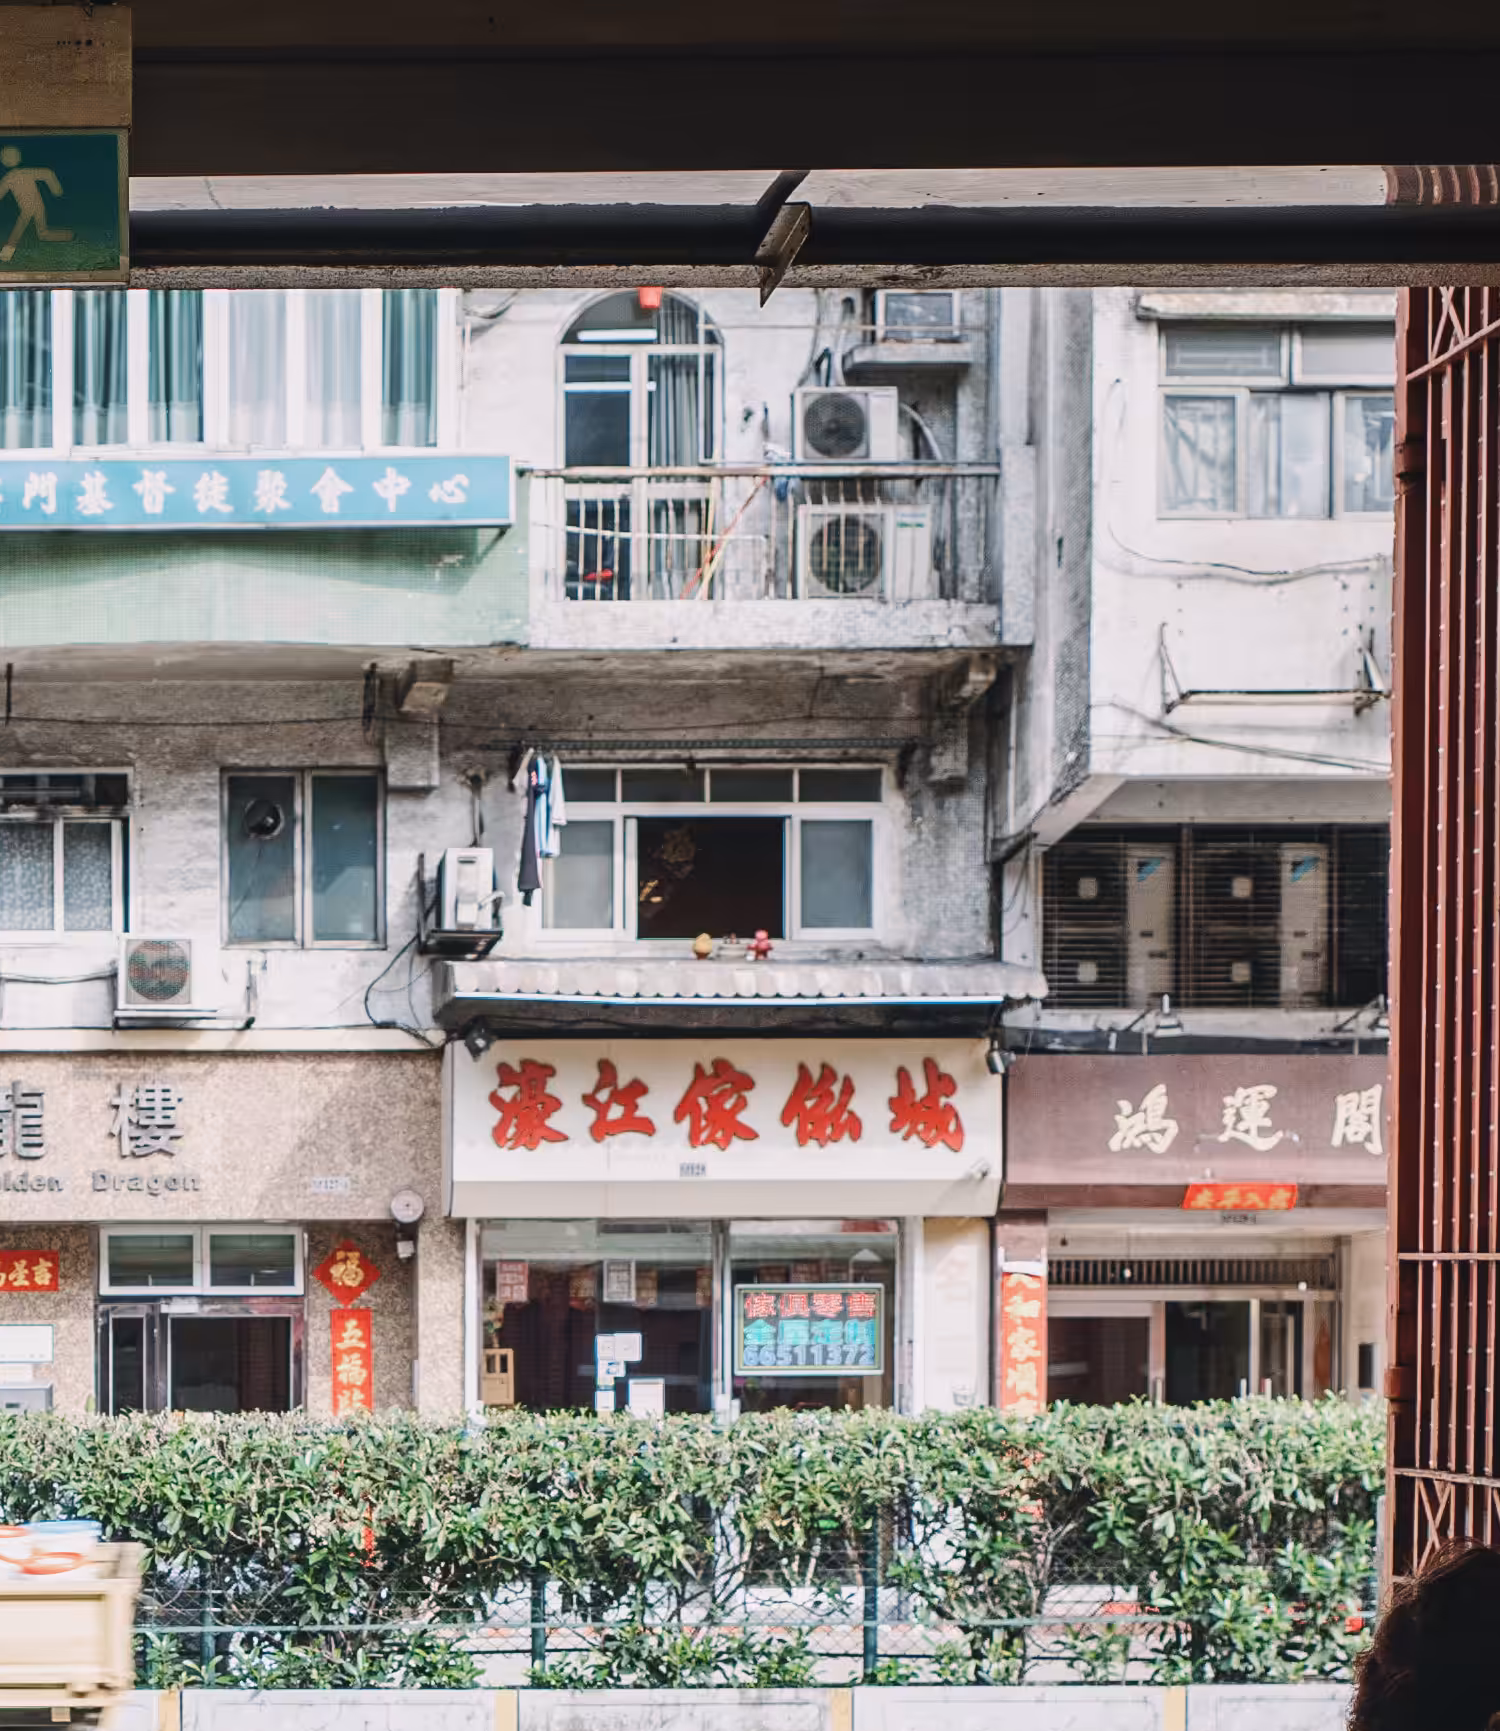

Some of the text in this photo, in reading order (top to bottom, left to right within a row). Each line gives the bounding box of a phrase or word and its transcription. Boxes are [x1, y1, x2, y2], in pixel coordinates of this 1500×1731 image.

[489, 1057, 966, 1153] 濠江傢俬城
[1107, 1083, 1387, 1156] 鴻運閣
[92, 1170, 200, 1195] Dragon
[329, 1250, 363, 1288] 福
